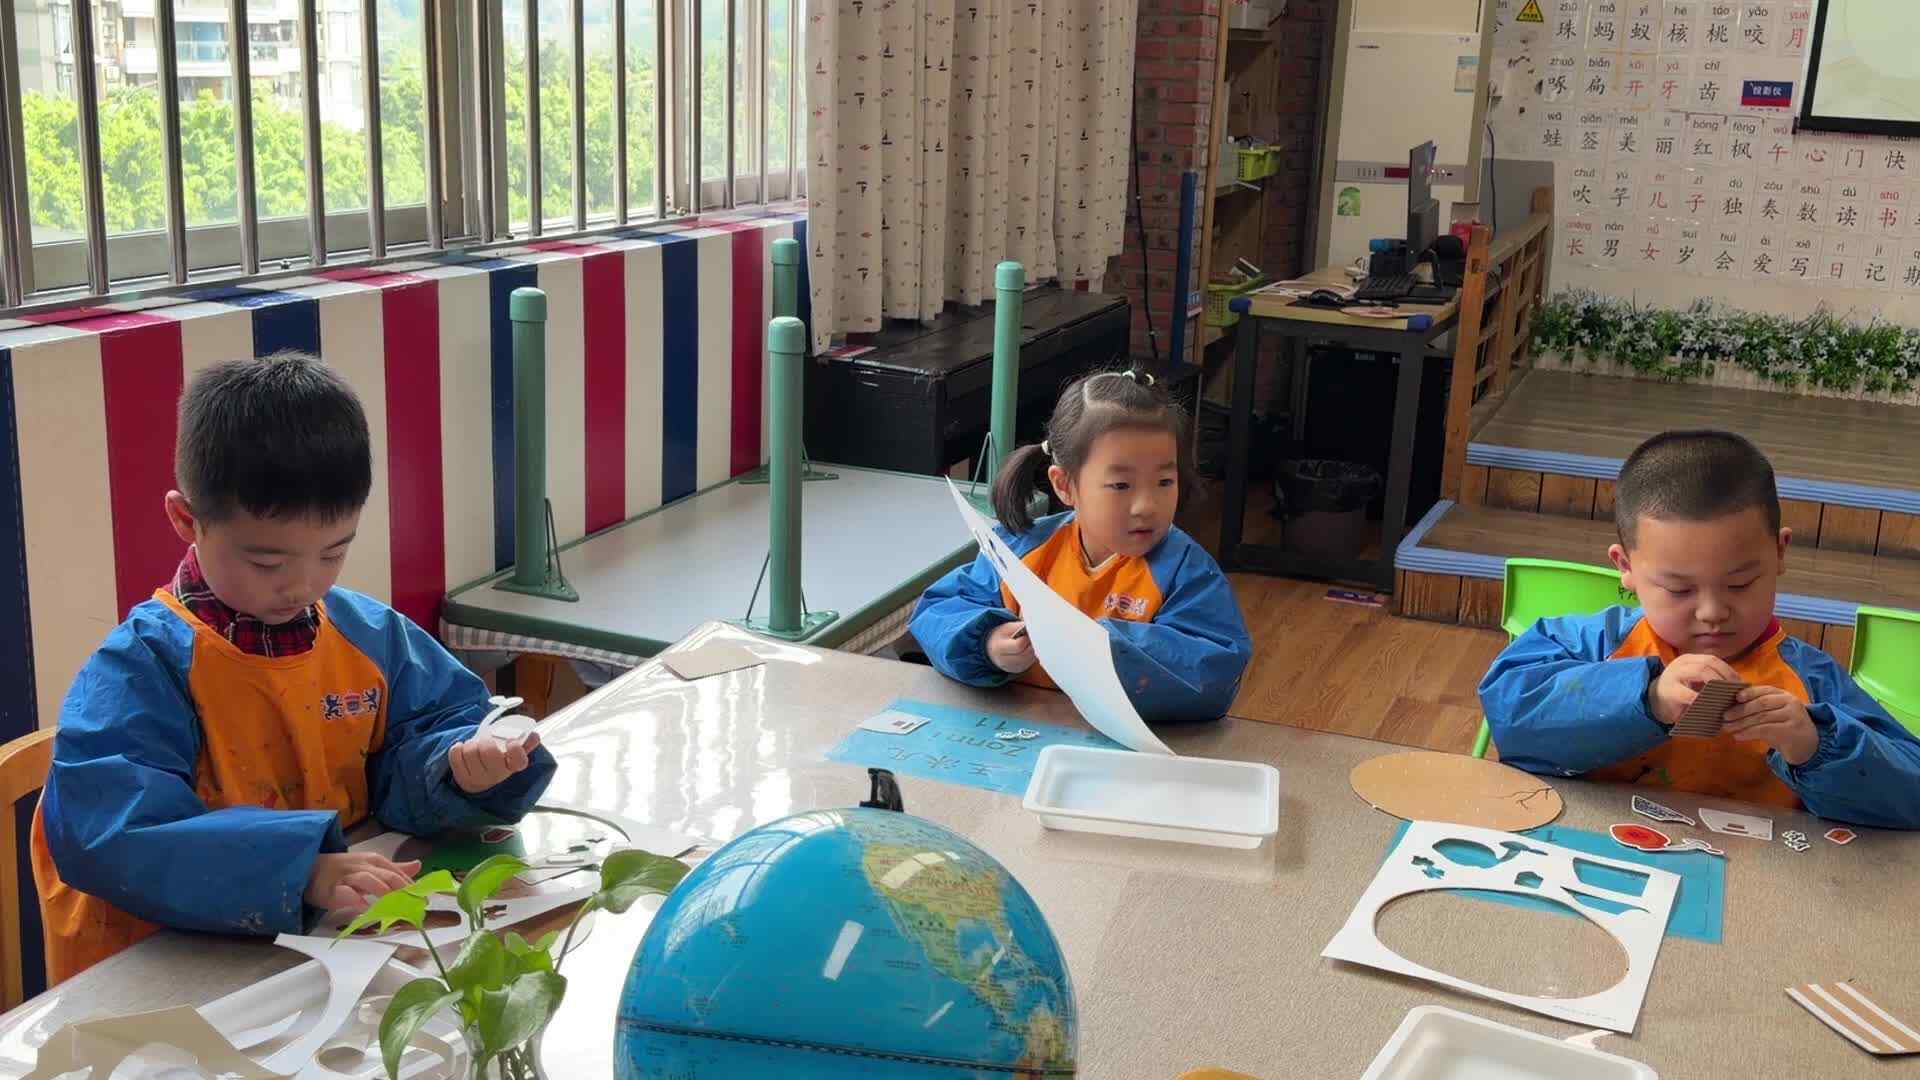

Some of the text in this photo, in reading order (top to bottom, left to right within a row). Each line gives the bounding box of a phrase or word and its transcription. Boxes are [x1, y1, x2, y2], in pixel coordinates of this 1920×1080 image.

[1556, 20, 1804, 48] 珠 蚂 蚁 核 桃 咬 月
[1548, 75, 1720, 101] 啄 扁 开 牙 齿
[1542, 128, 1907, 170] 蛙 签 美 丽 红 枫 午 心 门 快
[1573, 185, 1591, 205] 吹
[1649, 191, 1669, 209] 儿
[1685, 192, 1705, 213] 子
[1720, 197, 1742, 215] 独
[1760, 198, 1784, 220] 奏
[1797, 201, 1817, 223] 数
[1836, 205, 1857, 226] 读
[1879, 207, 1898, 228] 书
[1567, 239, 1585, 256] 长
[1601, 239, 1620, 257] 男
[1639, 241, 1661, 261] 女
[1677, 246, 1695, 264] 岁
[1712, 250, 1735, 270] 会
[1752, 253, 1772, 274] 爱
[1789, 257, 1809, 277] 写
[1830, 263, 1843, 279] 日
[1864, 263, 1886, 281] 记
